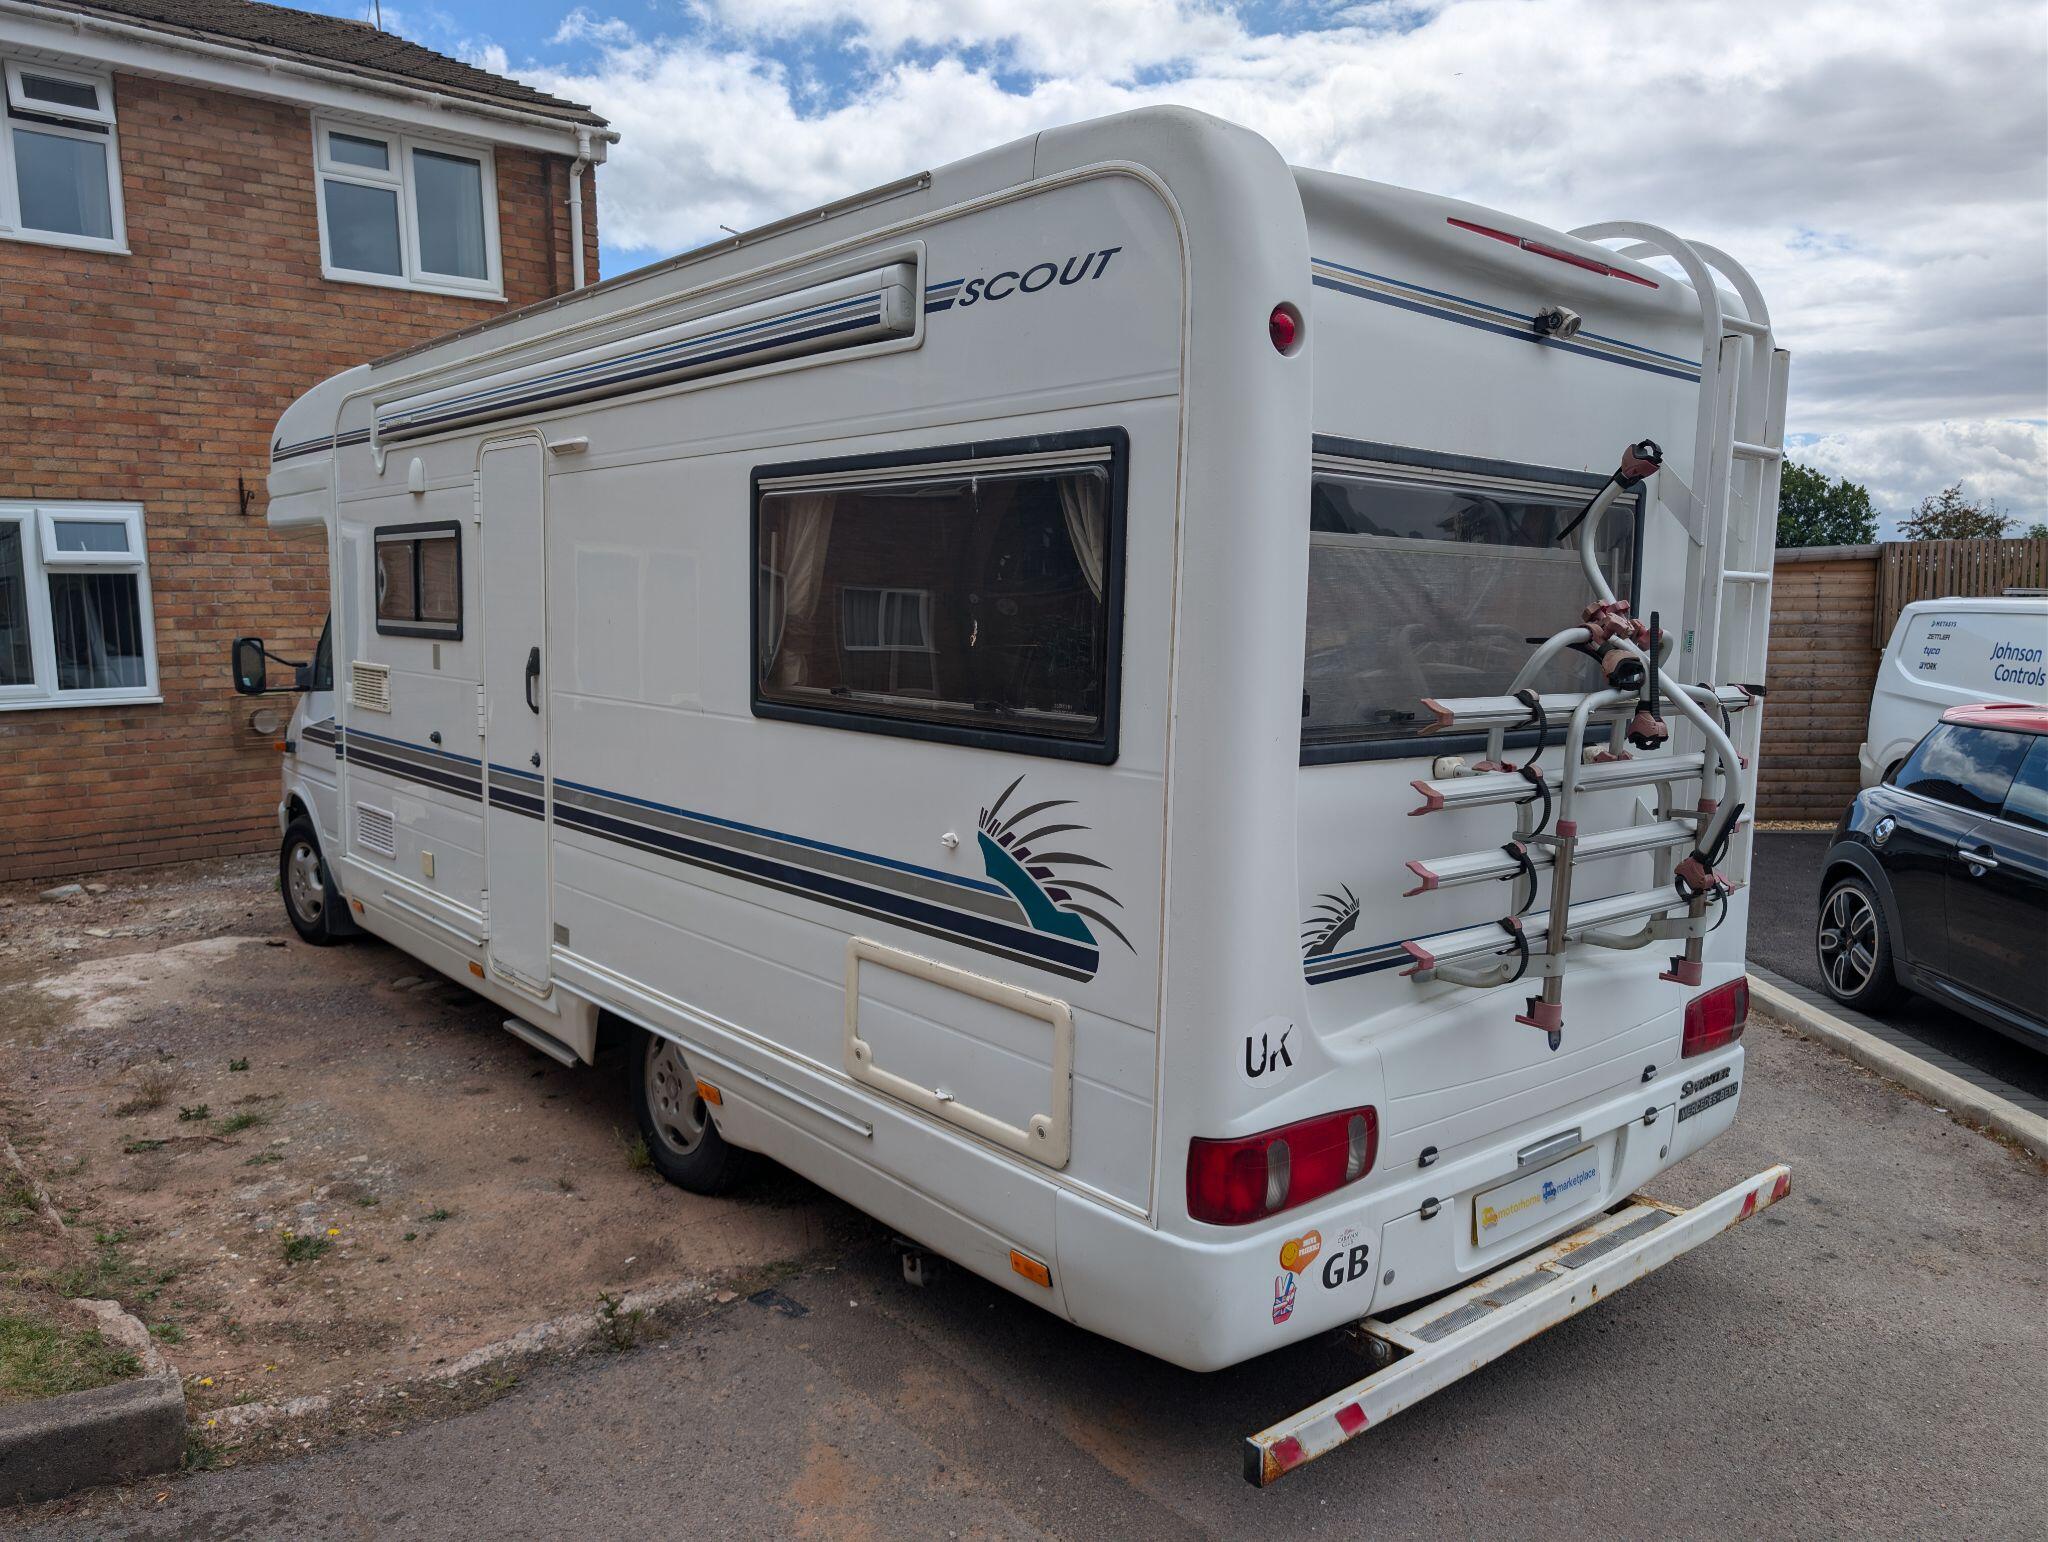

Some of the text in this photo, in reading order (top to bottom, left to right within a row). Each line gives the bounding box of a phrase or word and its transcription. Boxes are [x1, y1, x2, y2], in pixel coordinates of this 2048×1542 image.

[958, 246, 1123, 307] SCOUT
[1923, 645, 1941, 657] tyco
[1924, 661, 1937, 670] YORK
[1990, 641, 2043, 663] Johnson
[1994, 664, 2047, 686] Controls
[1679, 1082, 1738, 1122] MERCEDES-BENZ
[1497, 1168, 1596, 1220] motorhome marketplace
[1322, 1244, 1369, 1289] GB
